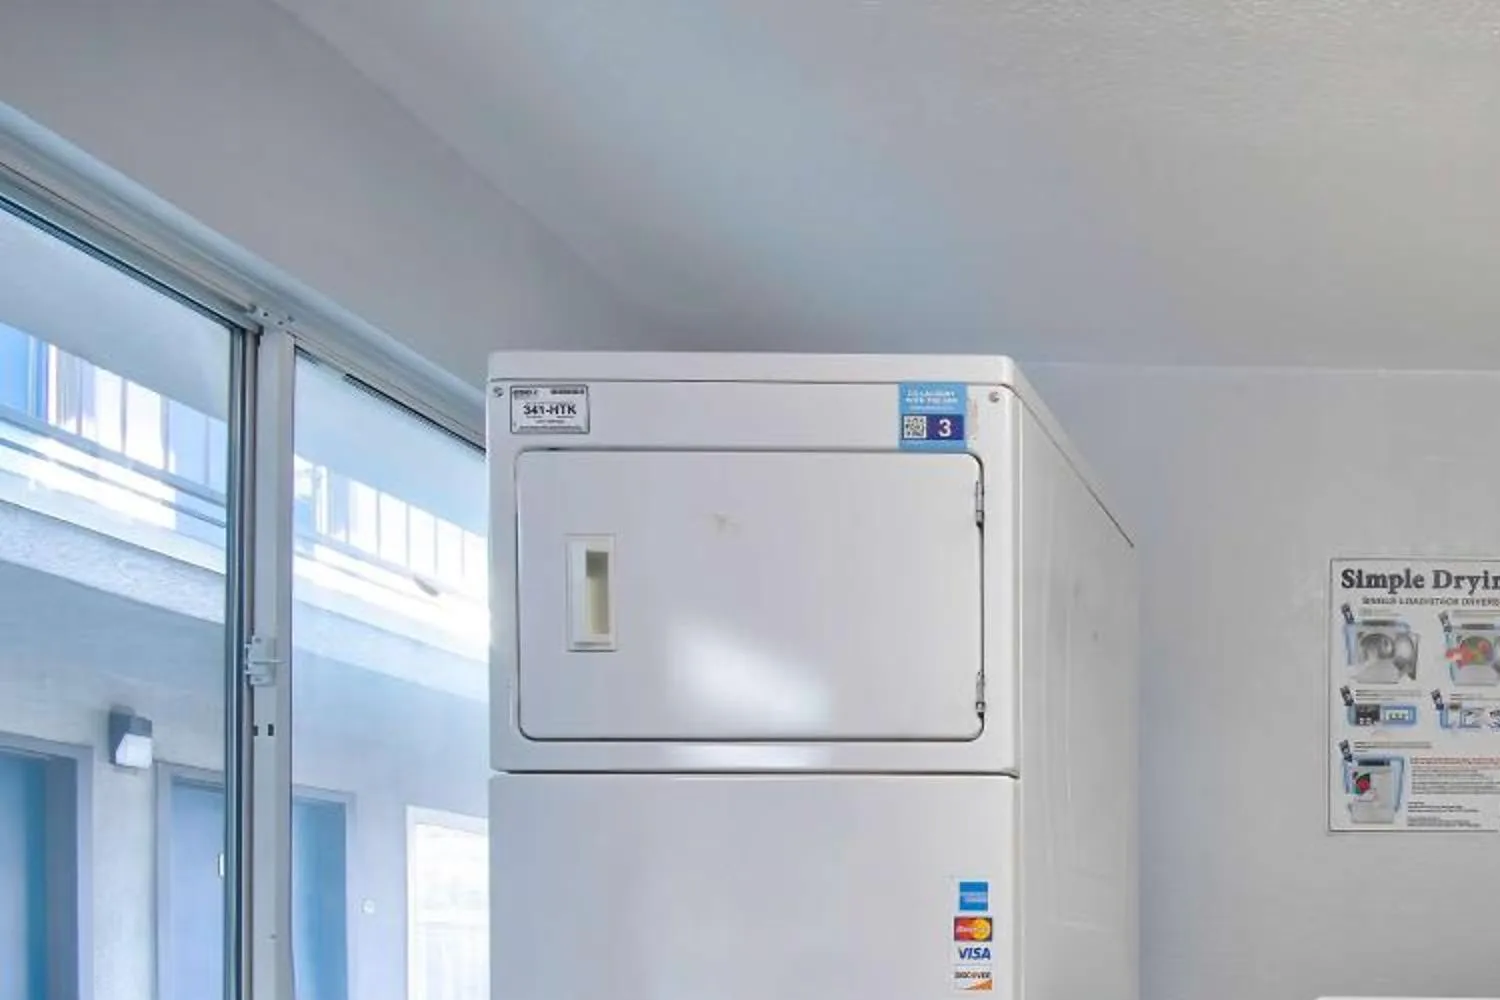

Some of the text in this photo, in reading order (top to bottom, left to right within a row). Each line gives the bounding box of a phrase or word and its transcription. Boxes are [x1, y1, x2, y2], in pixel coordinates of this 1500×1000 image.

[523, 404, 577, 415] 341-HTK
[938, 418, 952, 437] 3
[1341, 567, 1425, 594] Simple
[958, 947, 991, 960] VISA
